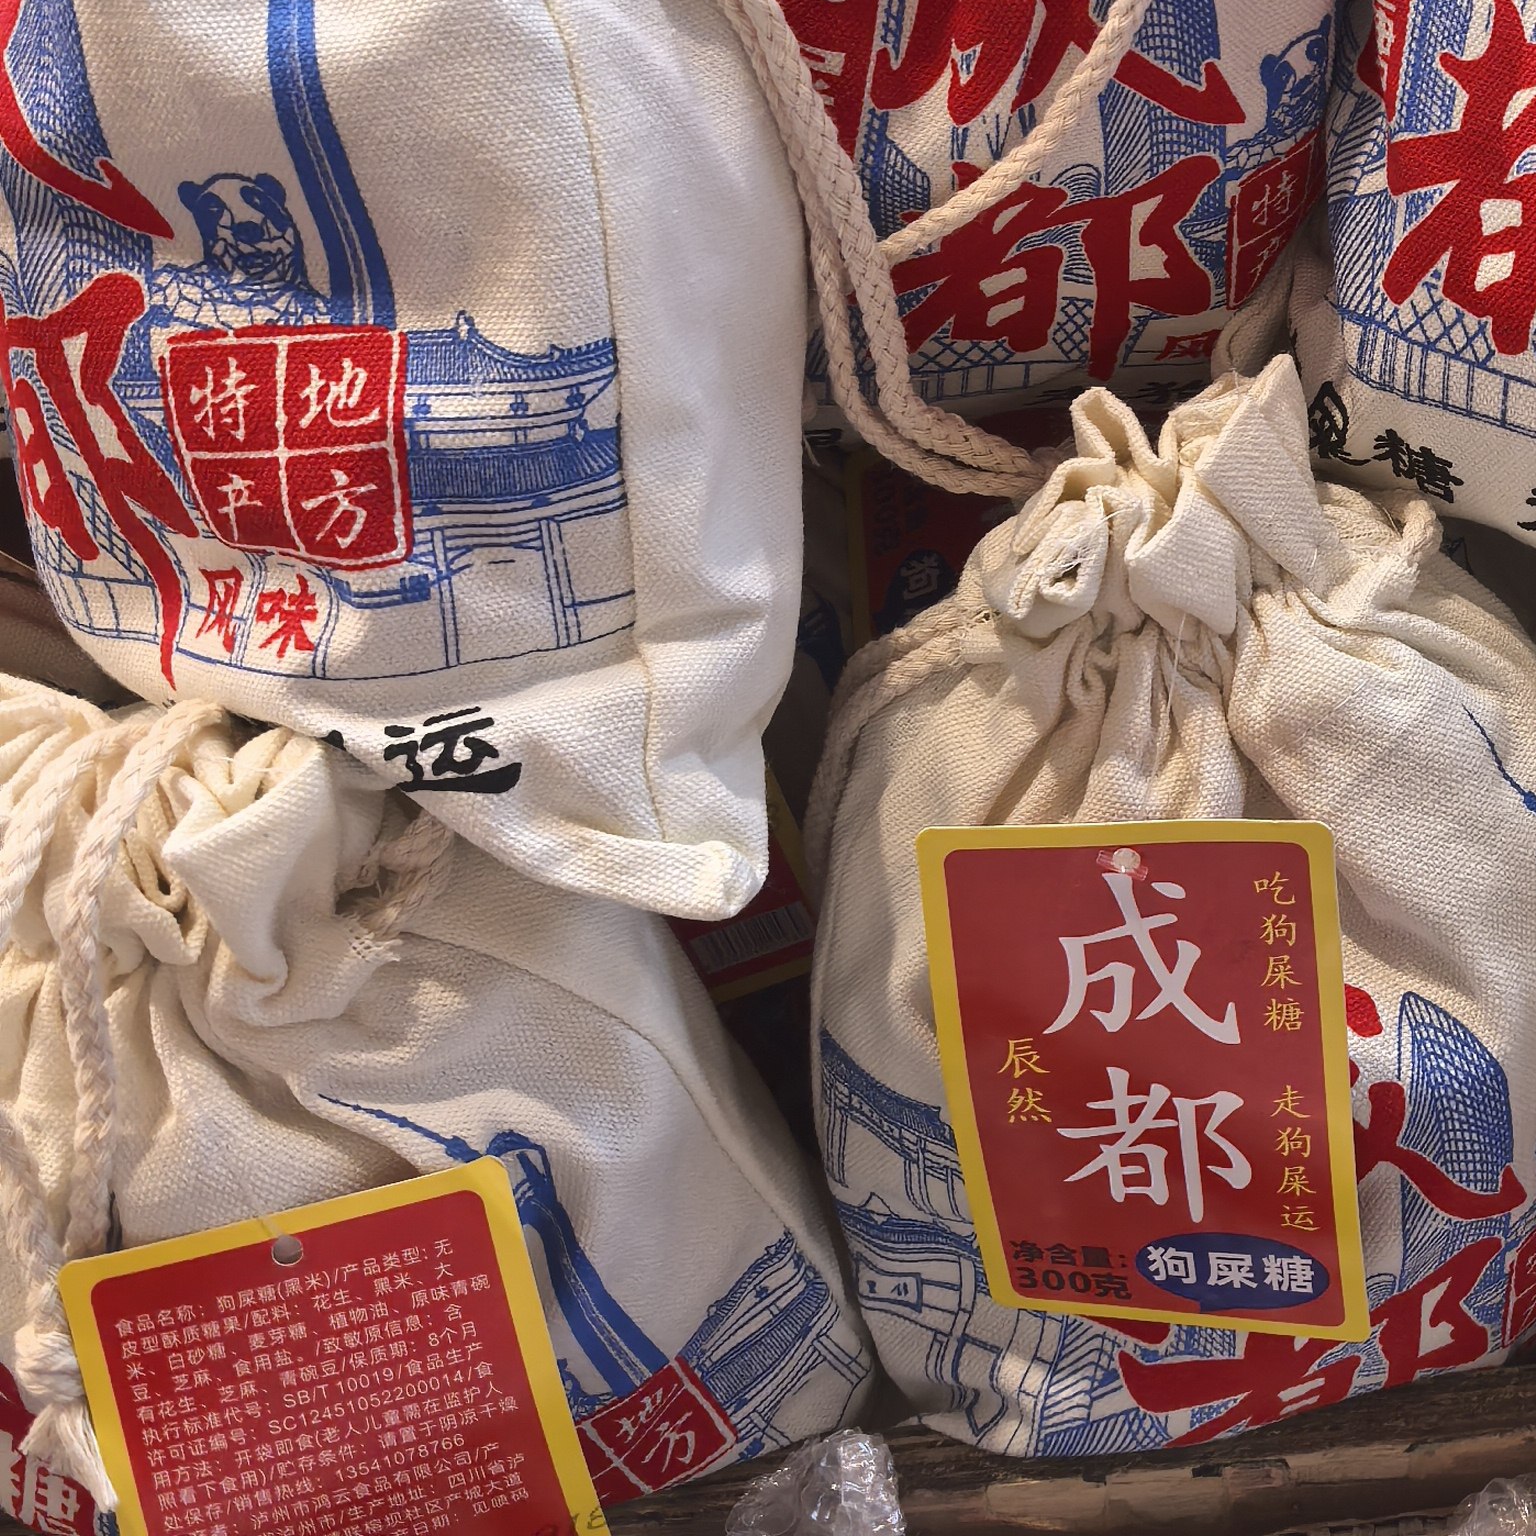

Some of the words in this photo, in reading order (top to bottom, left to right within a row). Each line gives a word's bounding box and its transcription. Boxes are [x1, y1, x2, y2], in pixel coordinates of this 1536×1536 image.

[189, 358, 265, 540] 特产
[299, 358, 380, 550] 地方
[198, 567, 321, 658] 风味
[1254, 872, 1304, 1032] 吃狗屎糖
[998, 1038, 1053, 1125] 辰然
[1043, 871, 1255, 1224] 成都
[1272, 1085, 1321, 1233] 走狗屎运
[1017, 1266, 1133, 1301] 300克
[1147, 1243, 1317, 1295] 狗屎糖
